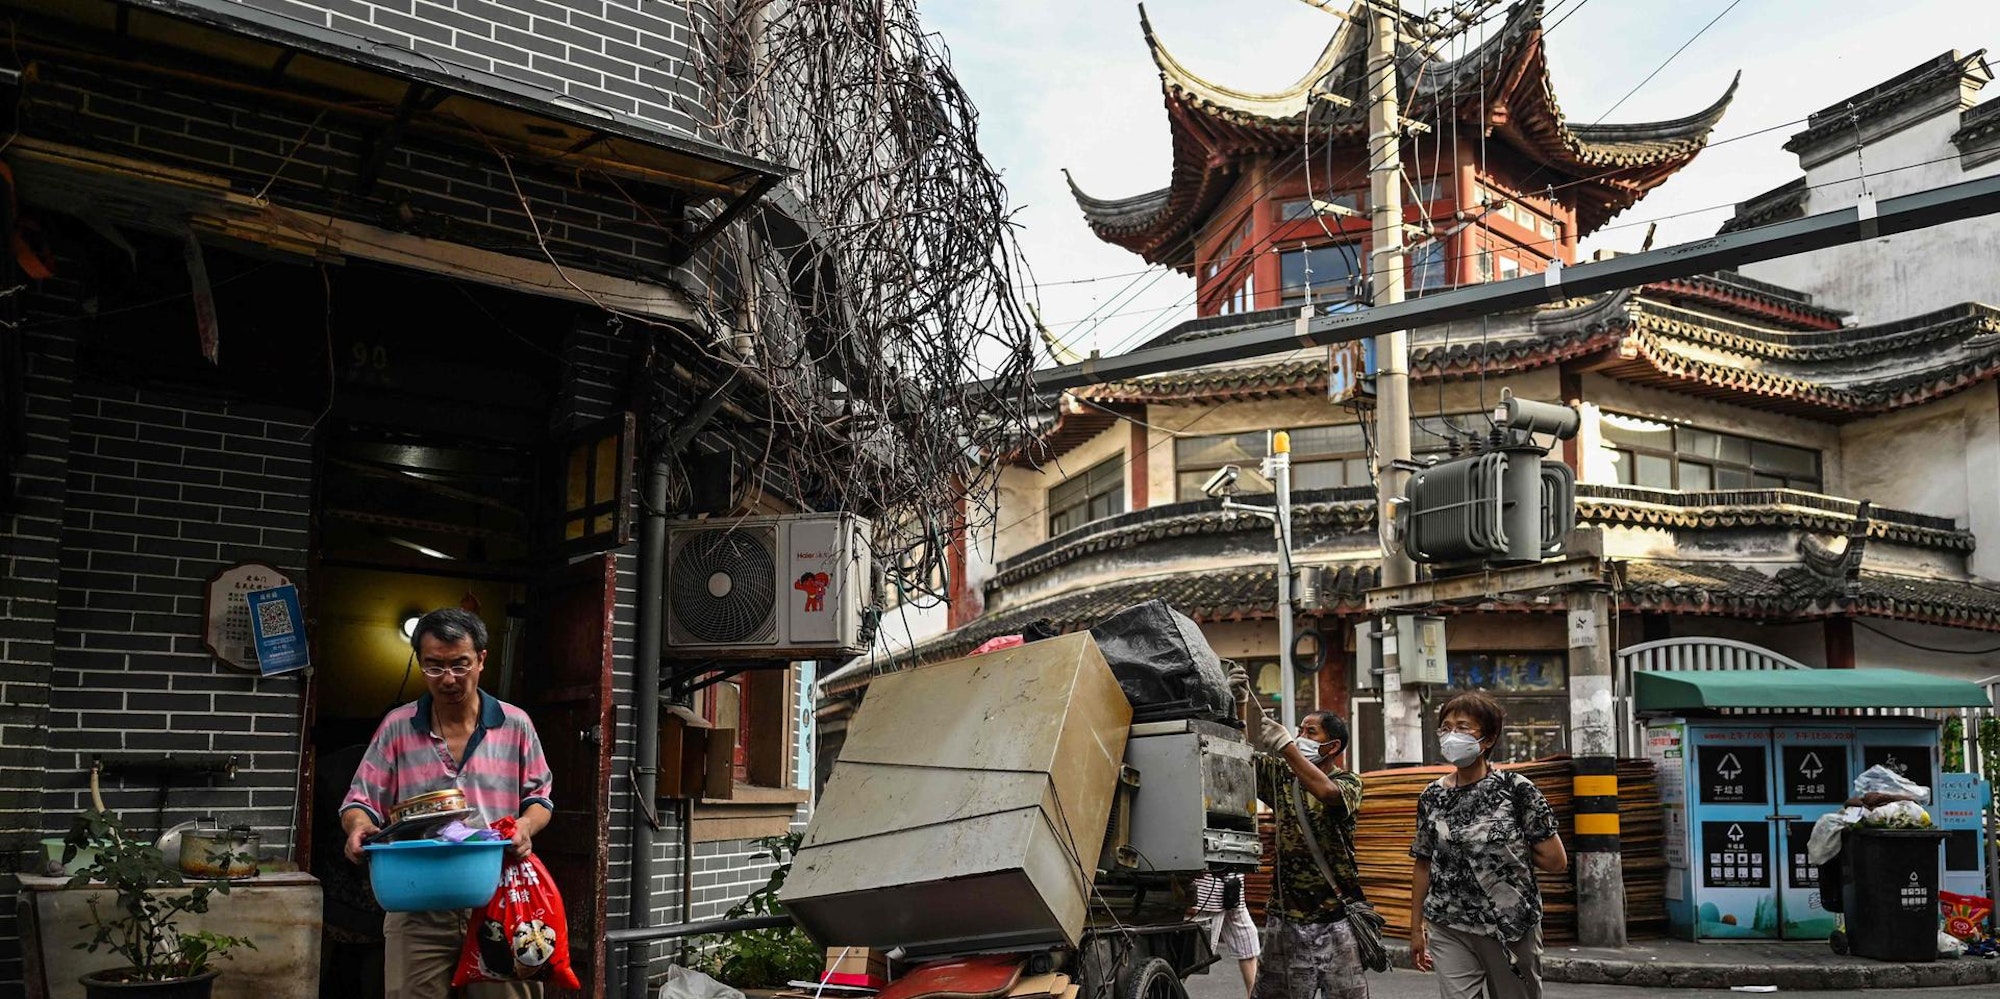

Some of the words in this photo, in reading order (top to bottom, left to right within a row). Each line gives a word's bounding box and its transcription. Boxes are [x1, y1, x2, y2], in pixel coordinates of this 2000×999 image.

[352, 342, 387, 369] 90
[1714, 784, 1744, 795] 干垃圾
[1797, 784, 1826, 795] 干垃圾
